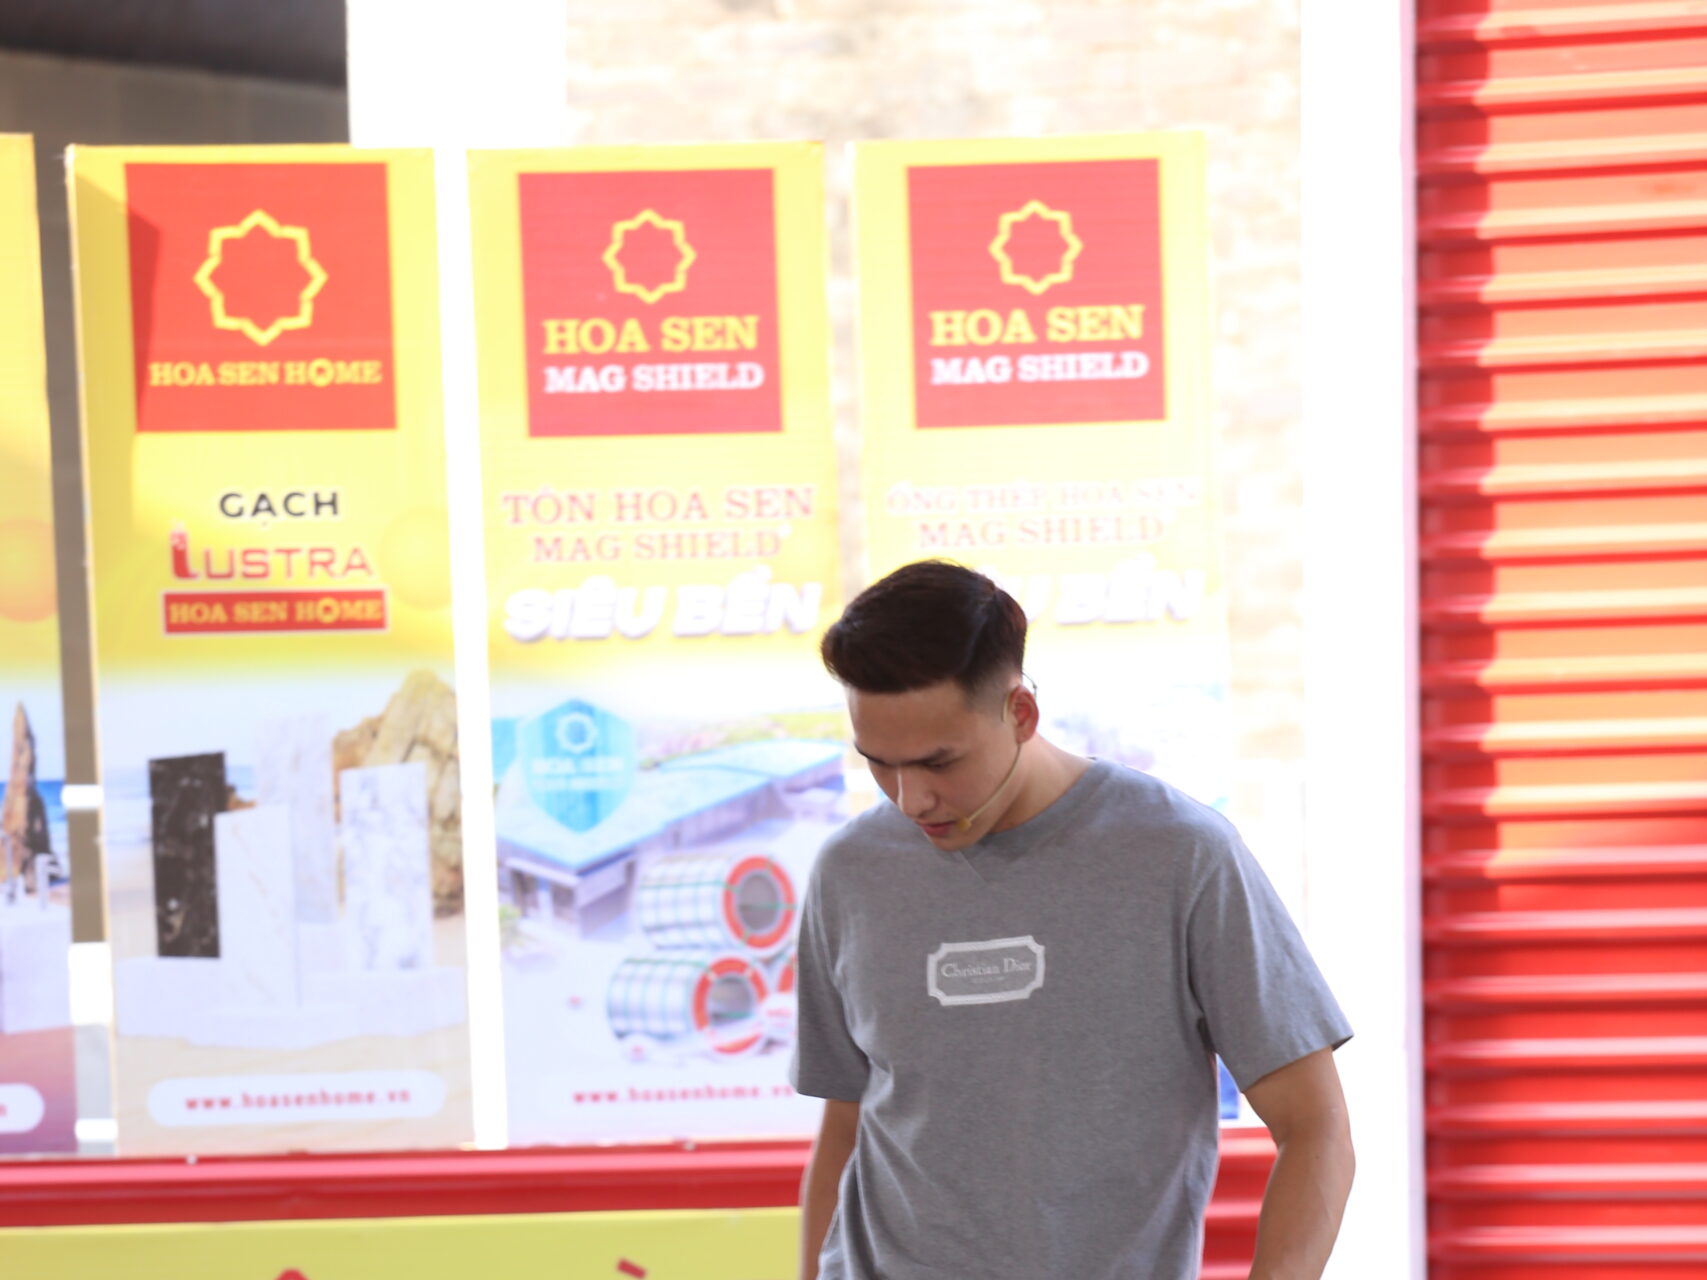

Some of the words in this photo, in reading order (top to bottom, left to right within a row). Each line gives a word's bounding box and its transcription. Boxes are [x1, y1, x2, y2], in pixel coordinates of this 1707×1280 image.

[542, 318, 650, 354] HOA
[660, 315, 759, 352] SEN
[929, 308, 1037, 346] HOA
[1046, 303, 1145, 342] SEN
[149, 361, 215, 386] HOA
[218, 360, 281, 386] SEN
[284, 357, 384, 387] HOME
[544, 364, 627, 393] MAG
[632, 361, 765, 391] SHIELD
[930, 355, 1012, 385] MAG
[1016, 350, 1150, 382] SHIELD
[219, 491, 339, 527] GẠCH
[502, 486, 596, 524] TÔN
[613, 491, 709, 522] HOA
[724, 487, 814, 520] SEN
[532, 535, 622, 562] MAG
[633, 530, 782, 560] SHIELD
[918, 520, 1006, 548] MAG
[1017, 515, 1164, 545] SHIELD
[168, 602, 228, 625] HOA
[233, 600, 288, 623] SEN
[295, 597, 383, 624] HOME
[504, 576, 667, 643] SIÊU
[1002, 957, 1034, 973] Dior
